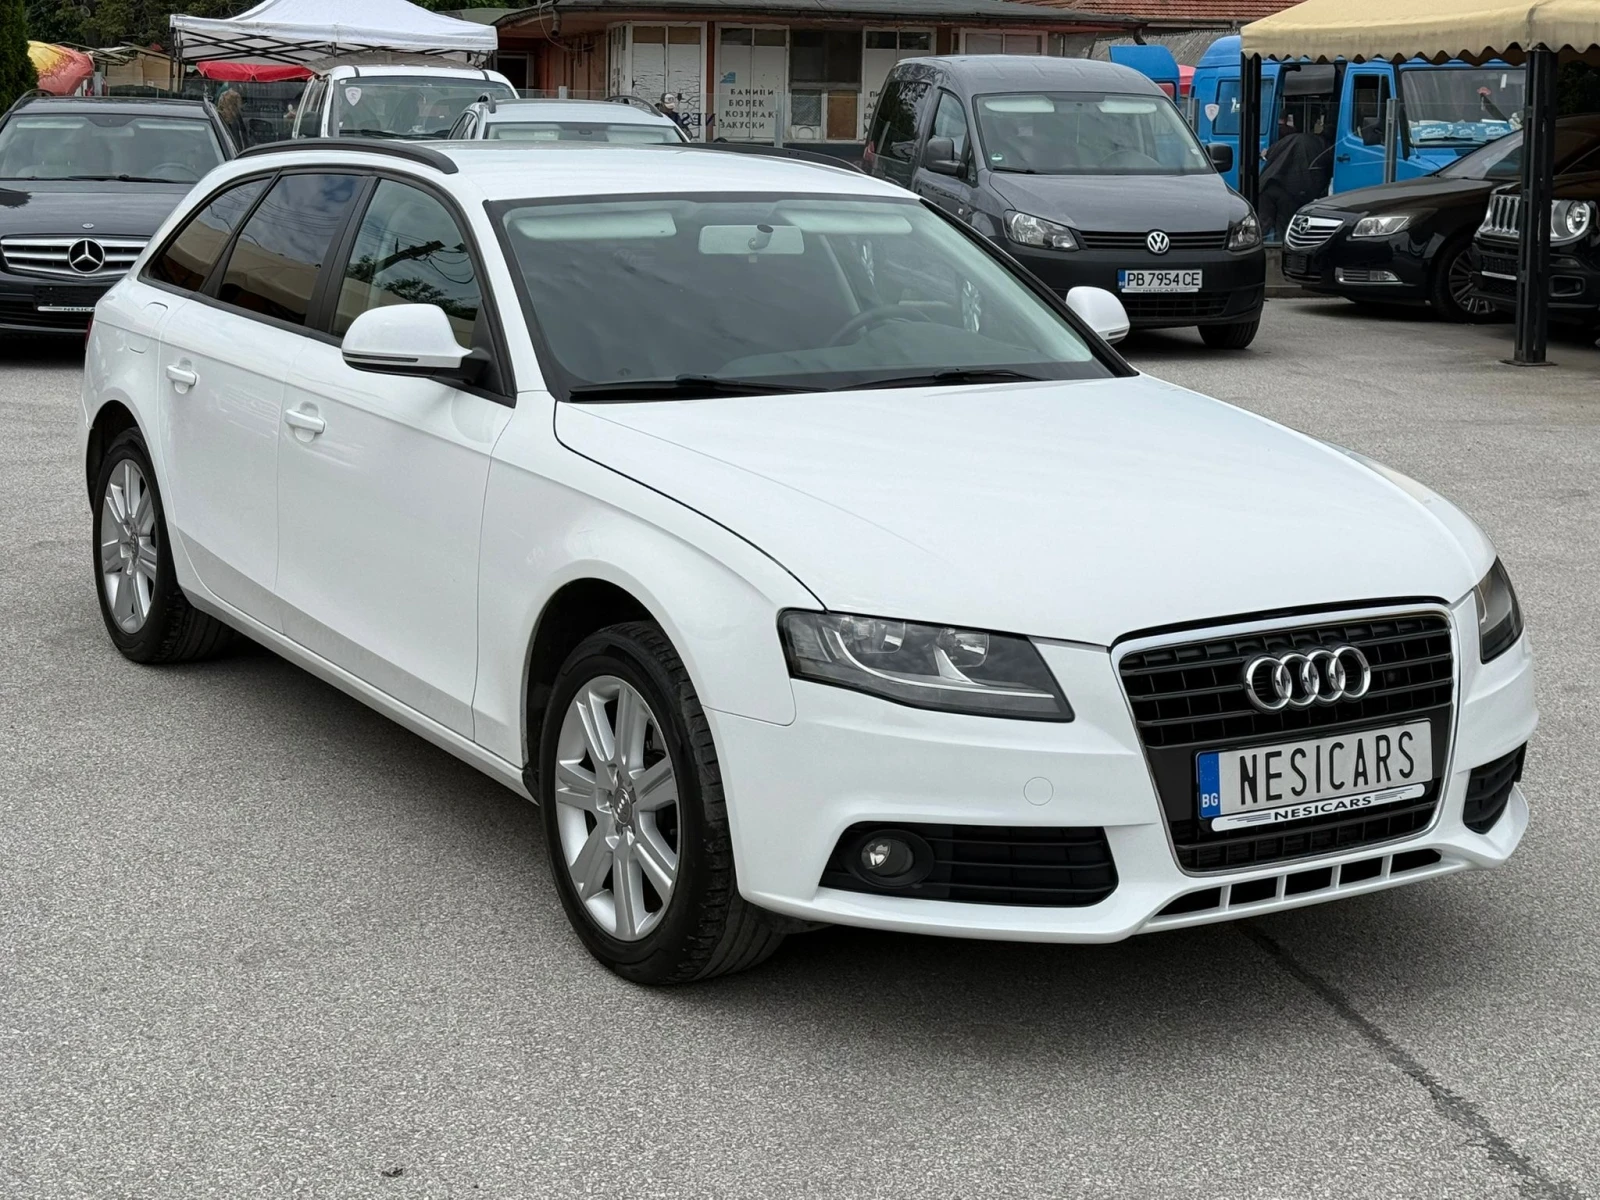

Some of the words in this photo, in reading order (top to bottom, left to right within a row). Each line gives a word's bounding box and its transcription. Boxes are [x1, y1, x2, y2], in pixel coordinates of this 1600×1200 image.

[728, 99, 765, 107] БЮРЕК
[725, 110, 775, 118] КОЗУНАК
[720, 121, 765, 129] ЗАКУСКИ
[1127, 272, 1145, 287] PB
[1147, 272, 1180, 287] 7954
[1182, 272, 1201, 286] CE
[1239, 731, 1415, 806] NESICARS
[1202, 792, 1219, 808] BG
[1273, 796, 1372, 821] NESICARS
